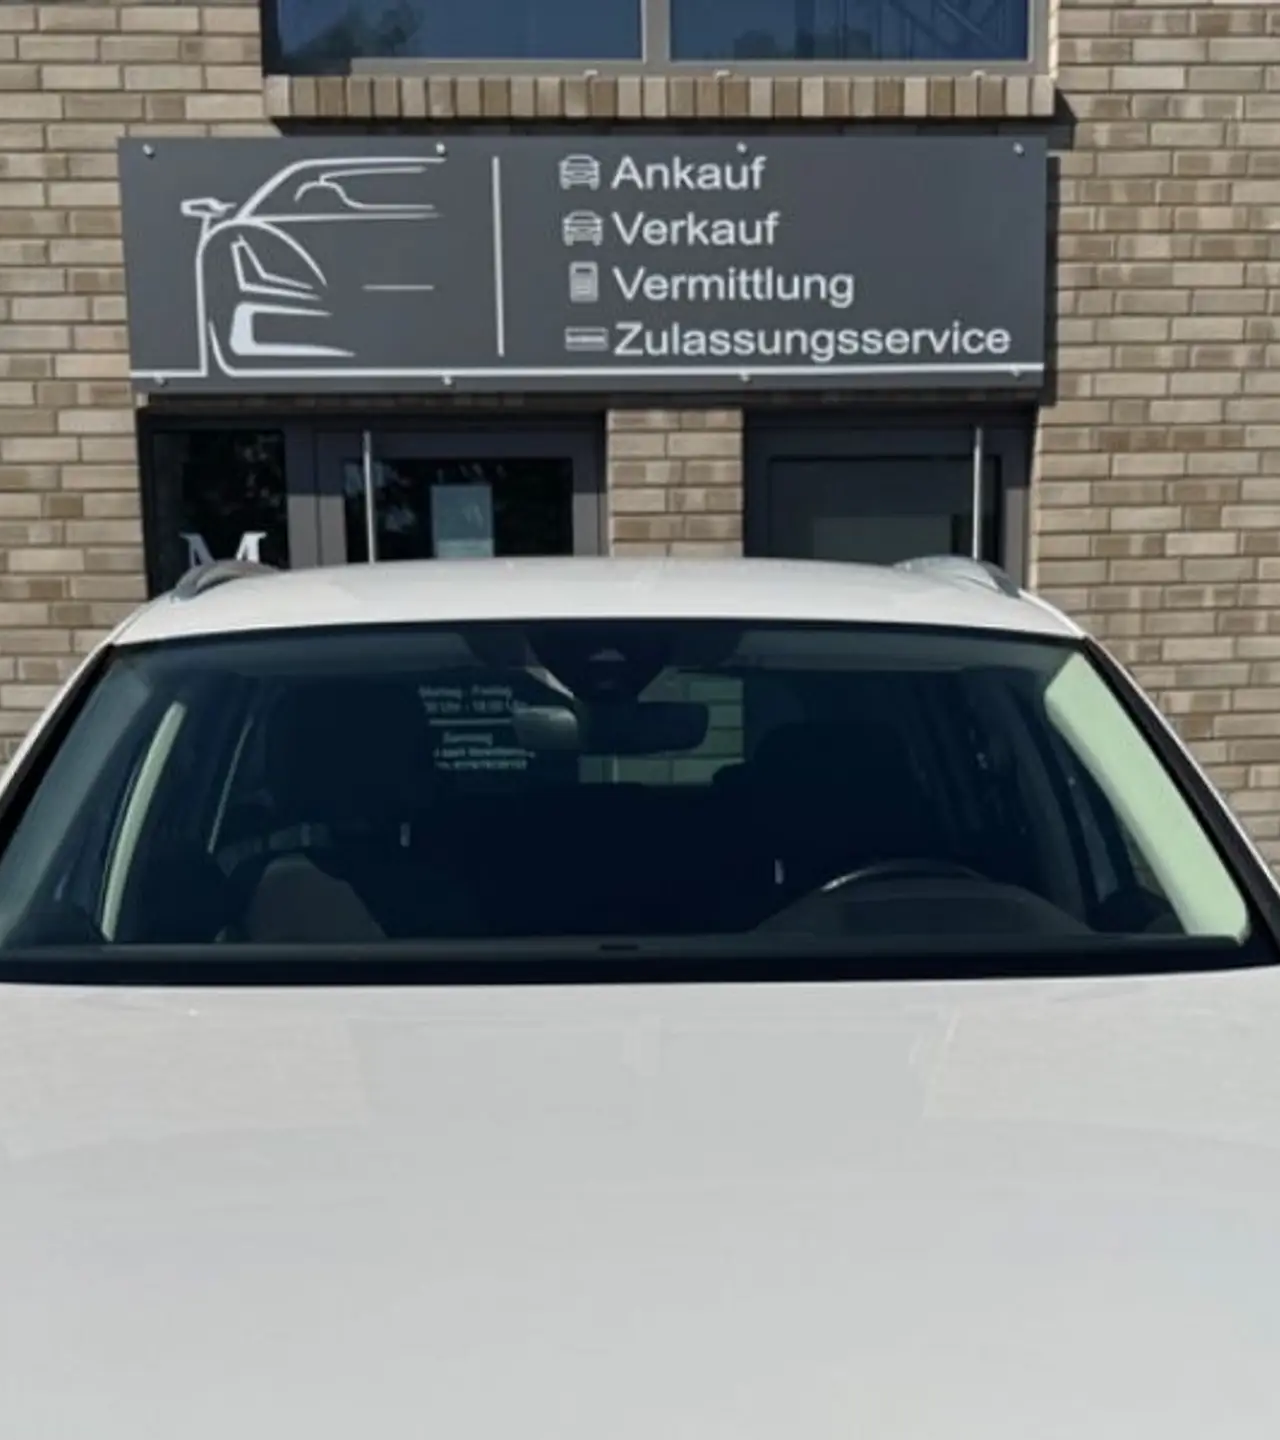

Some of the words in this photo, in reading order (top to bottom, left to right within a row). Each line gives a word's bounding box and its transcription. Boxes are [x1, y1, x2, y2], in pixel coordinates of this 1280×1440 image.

[611, 154, 766, 191] Ankauf
[611, 210, 780, 247] Verkauf
[612, 266, 855, 310] Vermittlung
[613, 320, 1012, 364] Zulassungsservice
